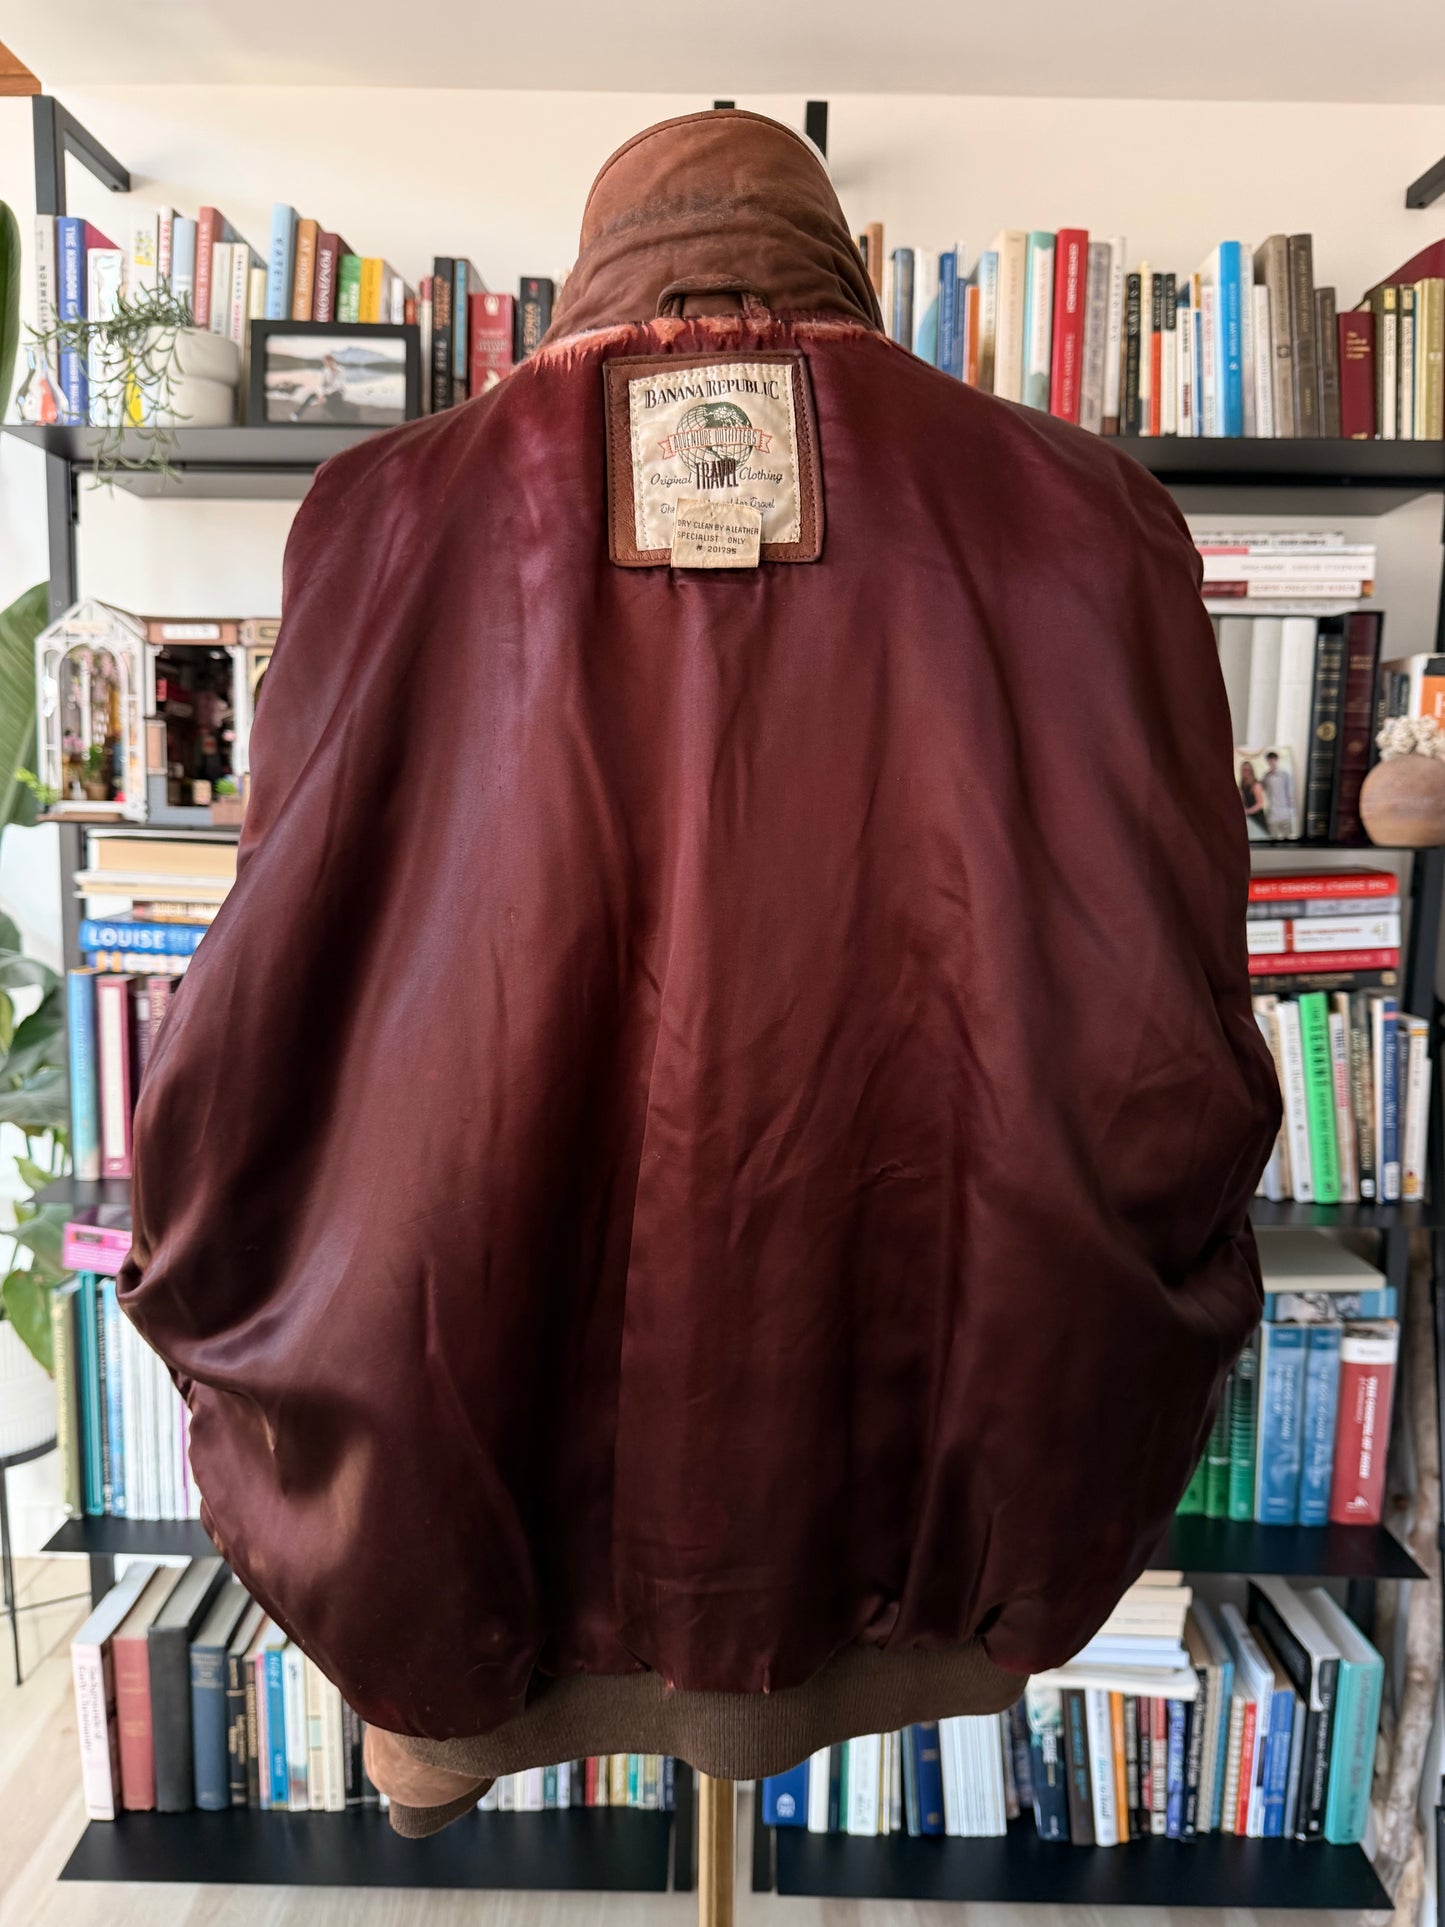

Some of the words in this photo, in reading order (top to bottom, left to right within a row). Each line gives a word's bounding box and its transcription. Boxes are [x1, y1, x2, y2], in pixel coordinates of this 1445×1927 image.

[644, 384, 704, 409] BANANA
[706, 378, 780, 400] REPUBLIC
[673, 429, 712, 450] ADVENTURE
[715, 427, 758, 445] OUTFITTERS
[650, 472, 693, 488] Original
[696, 458, 739, 490] TRAVEL
[739, 467, 783, 484] Clothing
[750, 496, 776, 509] Travel
[676, 530, 720, 542] SPECIALIST
[727, 536, 746, 545] ONLY
[677, 519, 692, 527] DRY
[693, 521, 714, 531] CLEAN
[714, 524, 725, 532] BY
[731, 525, 759, 535] LEATHER
[89, 927, 167, 950] LOUISE
